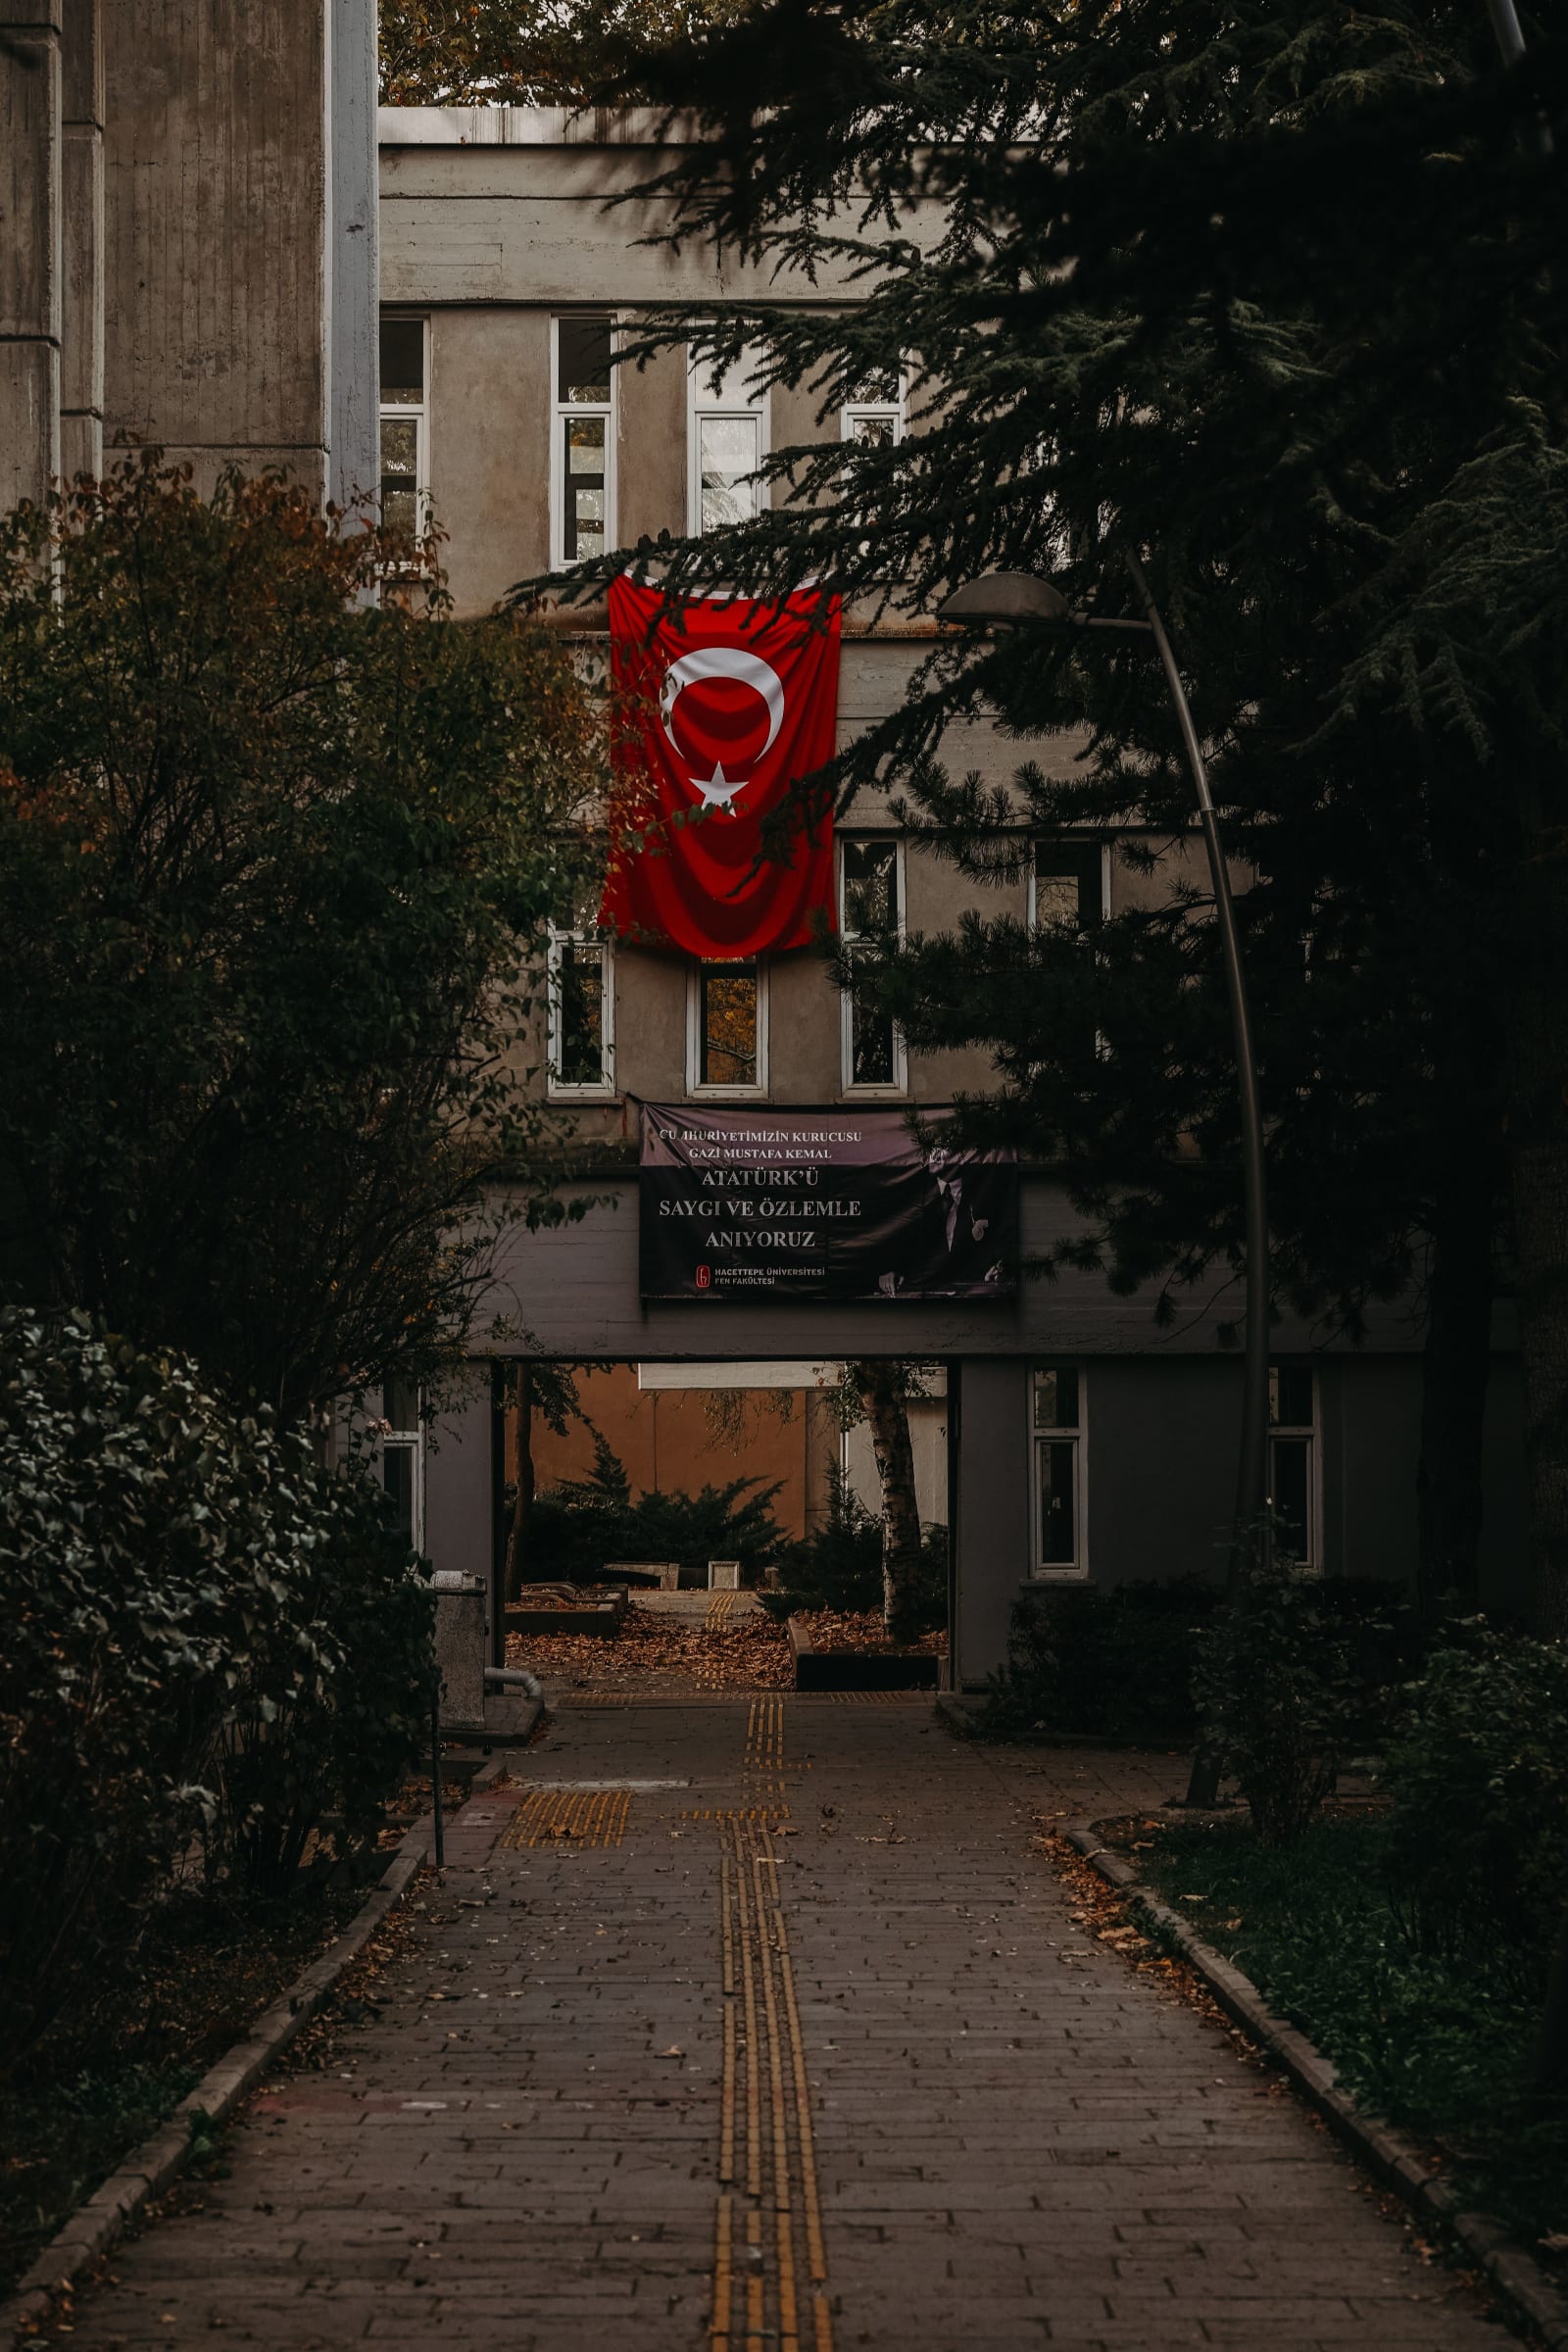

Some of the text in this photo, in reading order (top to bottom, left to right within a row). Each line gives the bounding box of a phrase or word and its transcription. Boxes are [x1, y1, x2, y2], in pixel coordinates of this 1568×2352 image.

[793, 1132, 862, 1143] KURUCUSU
[689, 1147, 832, 1158] GAZİ MUSTAFA KEMAL
[701, 1166, 819, 1187] ATATÜRK'Ü
[659, 1197, 861, 1216] SAYGI VE ÖZLEMLE
[705, 1231, 816, 1248] ANIYORUZ
[714, 1266, 825, 1276] HACETTEPE ÜNİVERSİTESİ
[714, 1276, 775, 1285] FEN FAKÜLTESİ
